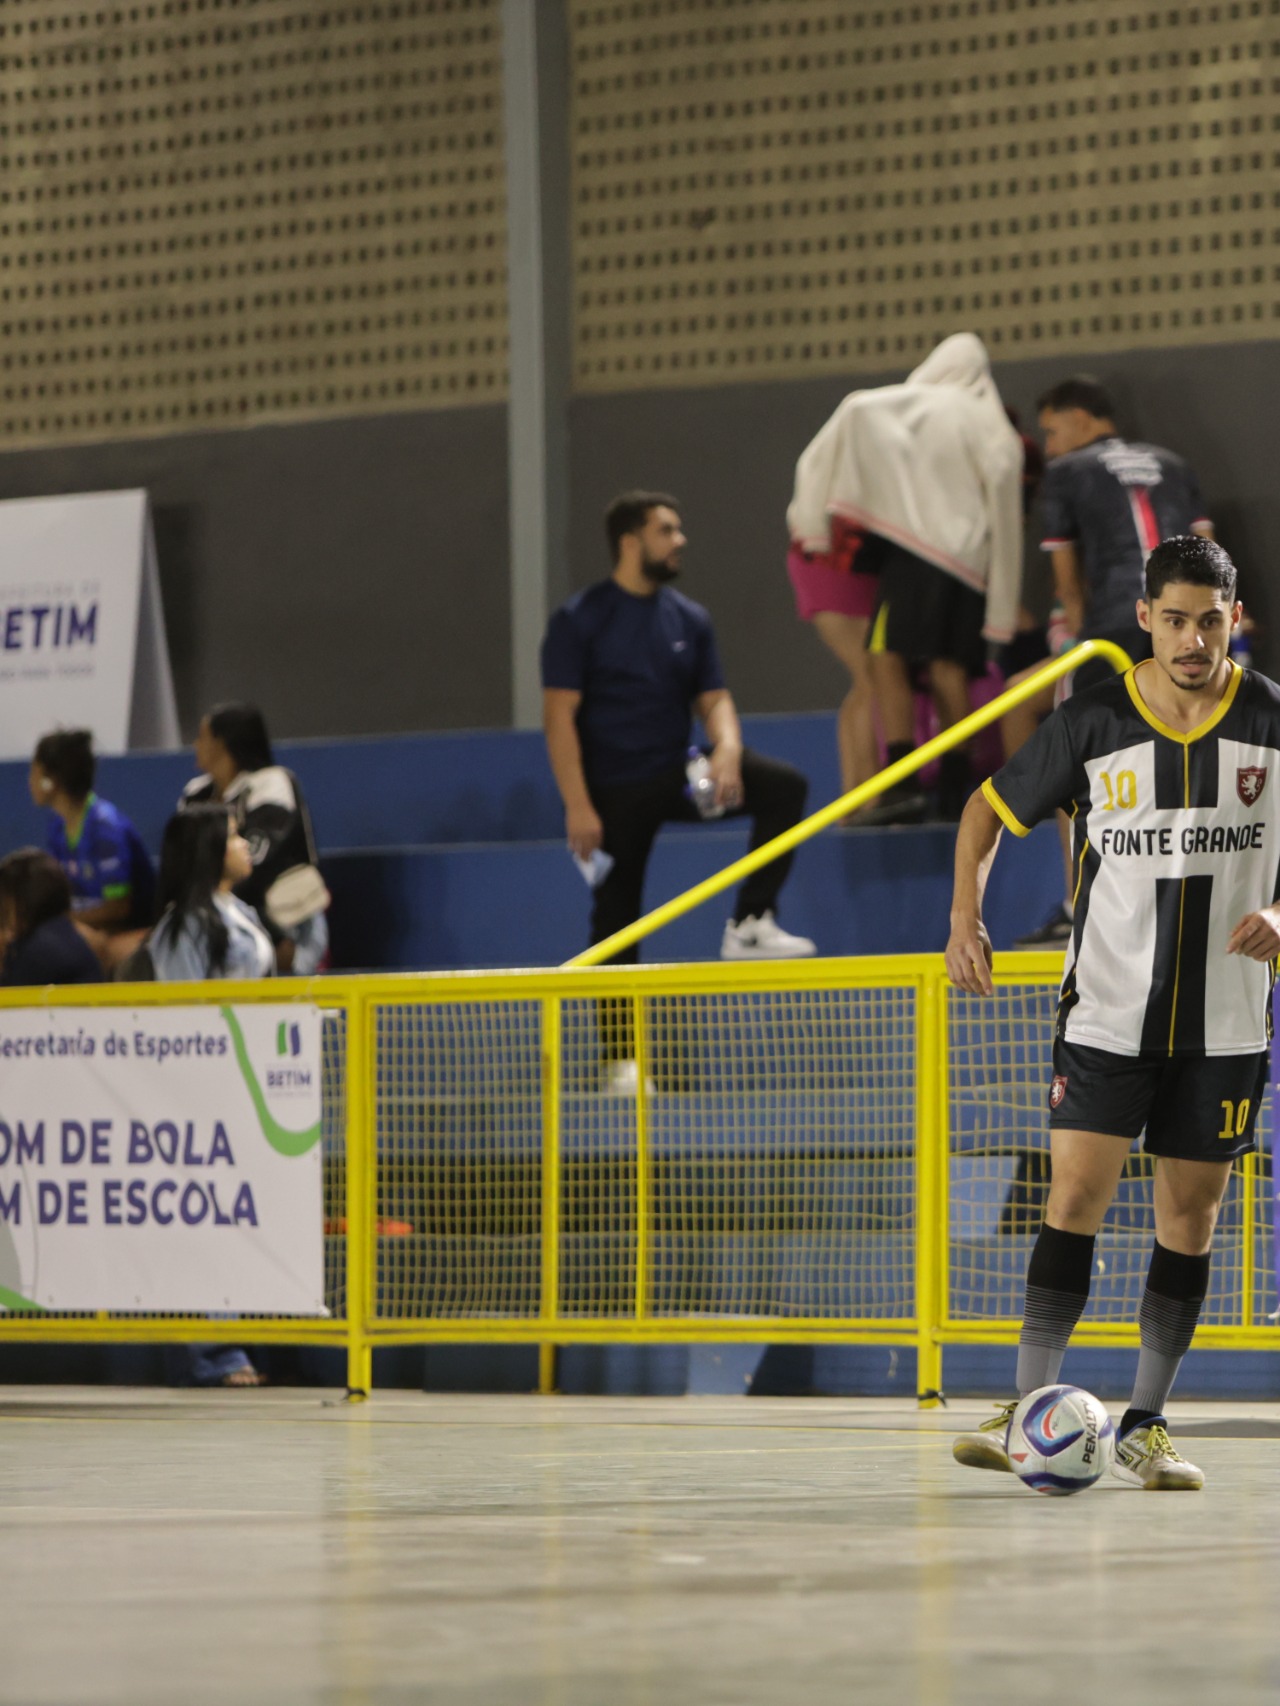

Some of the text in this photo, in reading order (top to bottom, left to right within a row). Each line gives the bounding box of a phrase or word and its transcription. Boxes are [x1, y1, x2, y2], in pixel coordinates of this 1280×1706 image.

[0, 605, 97, 650] ETIM
[1099, 769, 1137, 811] 10
[1101, 822, 1266, 856] FONTE GRANDE
[0, 1028, 228, 1063] ecretaria de Esportes
[267, 1070, 311, 1086] BETIM
[1218, 1098, 1250, 1139] 10
[61, 1120, 112, 1164] DE
[128, 1120, 236, 1166] BOLA
[38, 1180, 89, 1225] DE
[103, 1180, 259, 1227] ESCOLA
[1081, 1398, 1098, 1464] PENALTY
